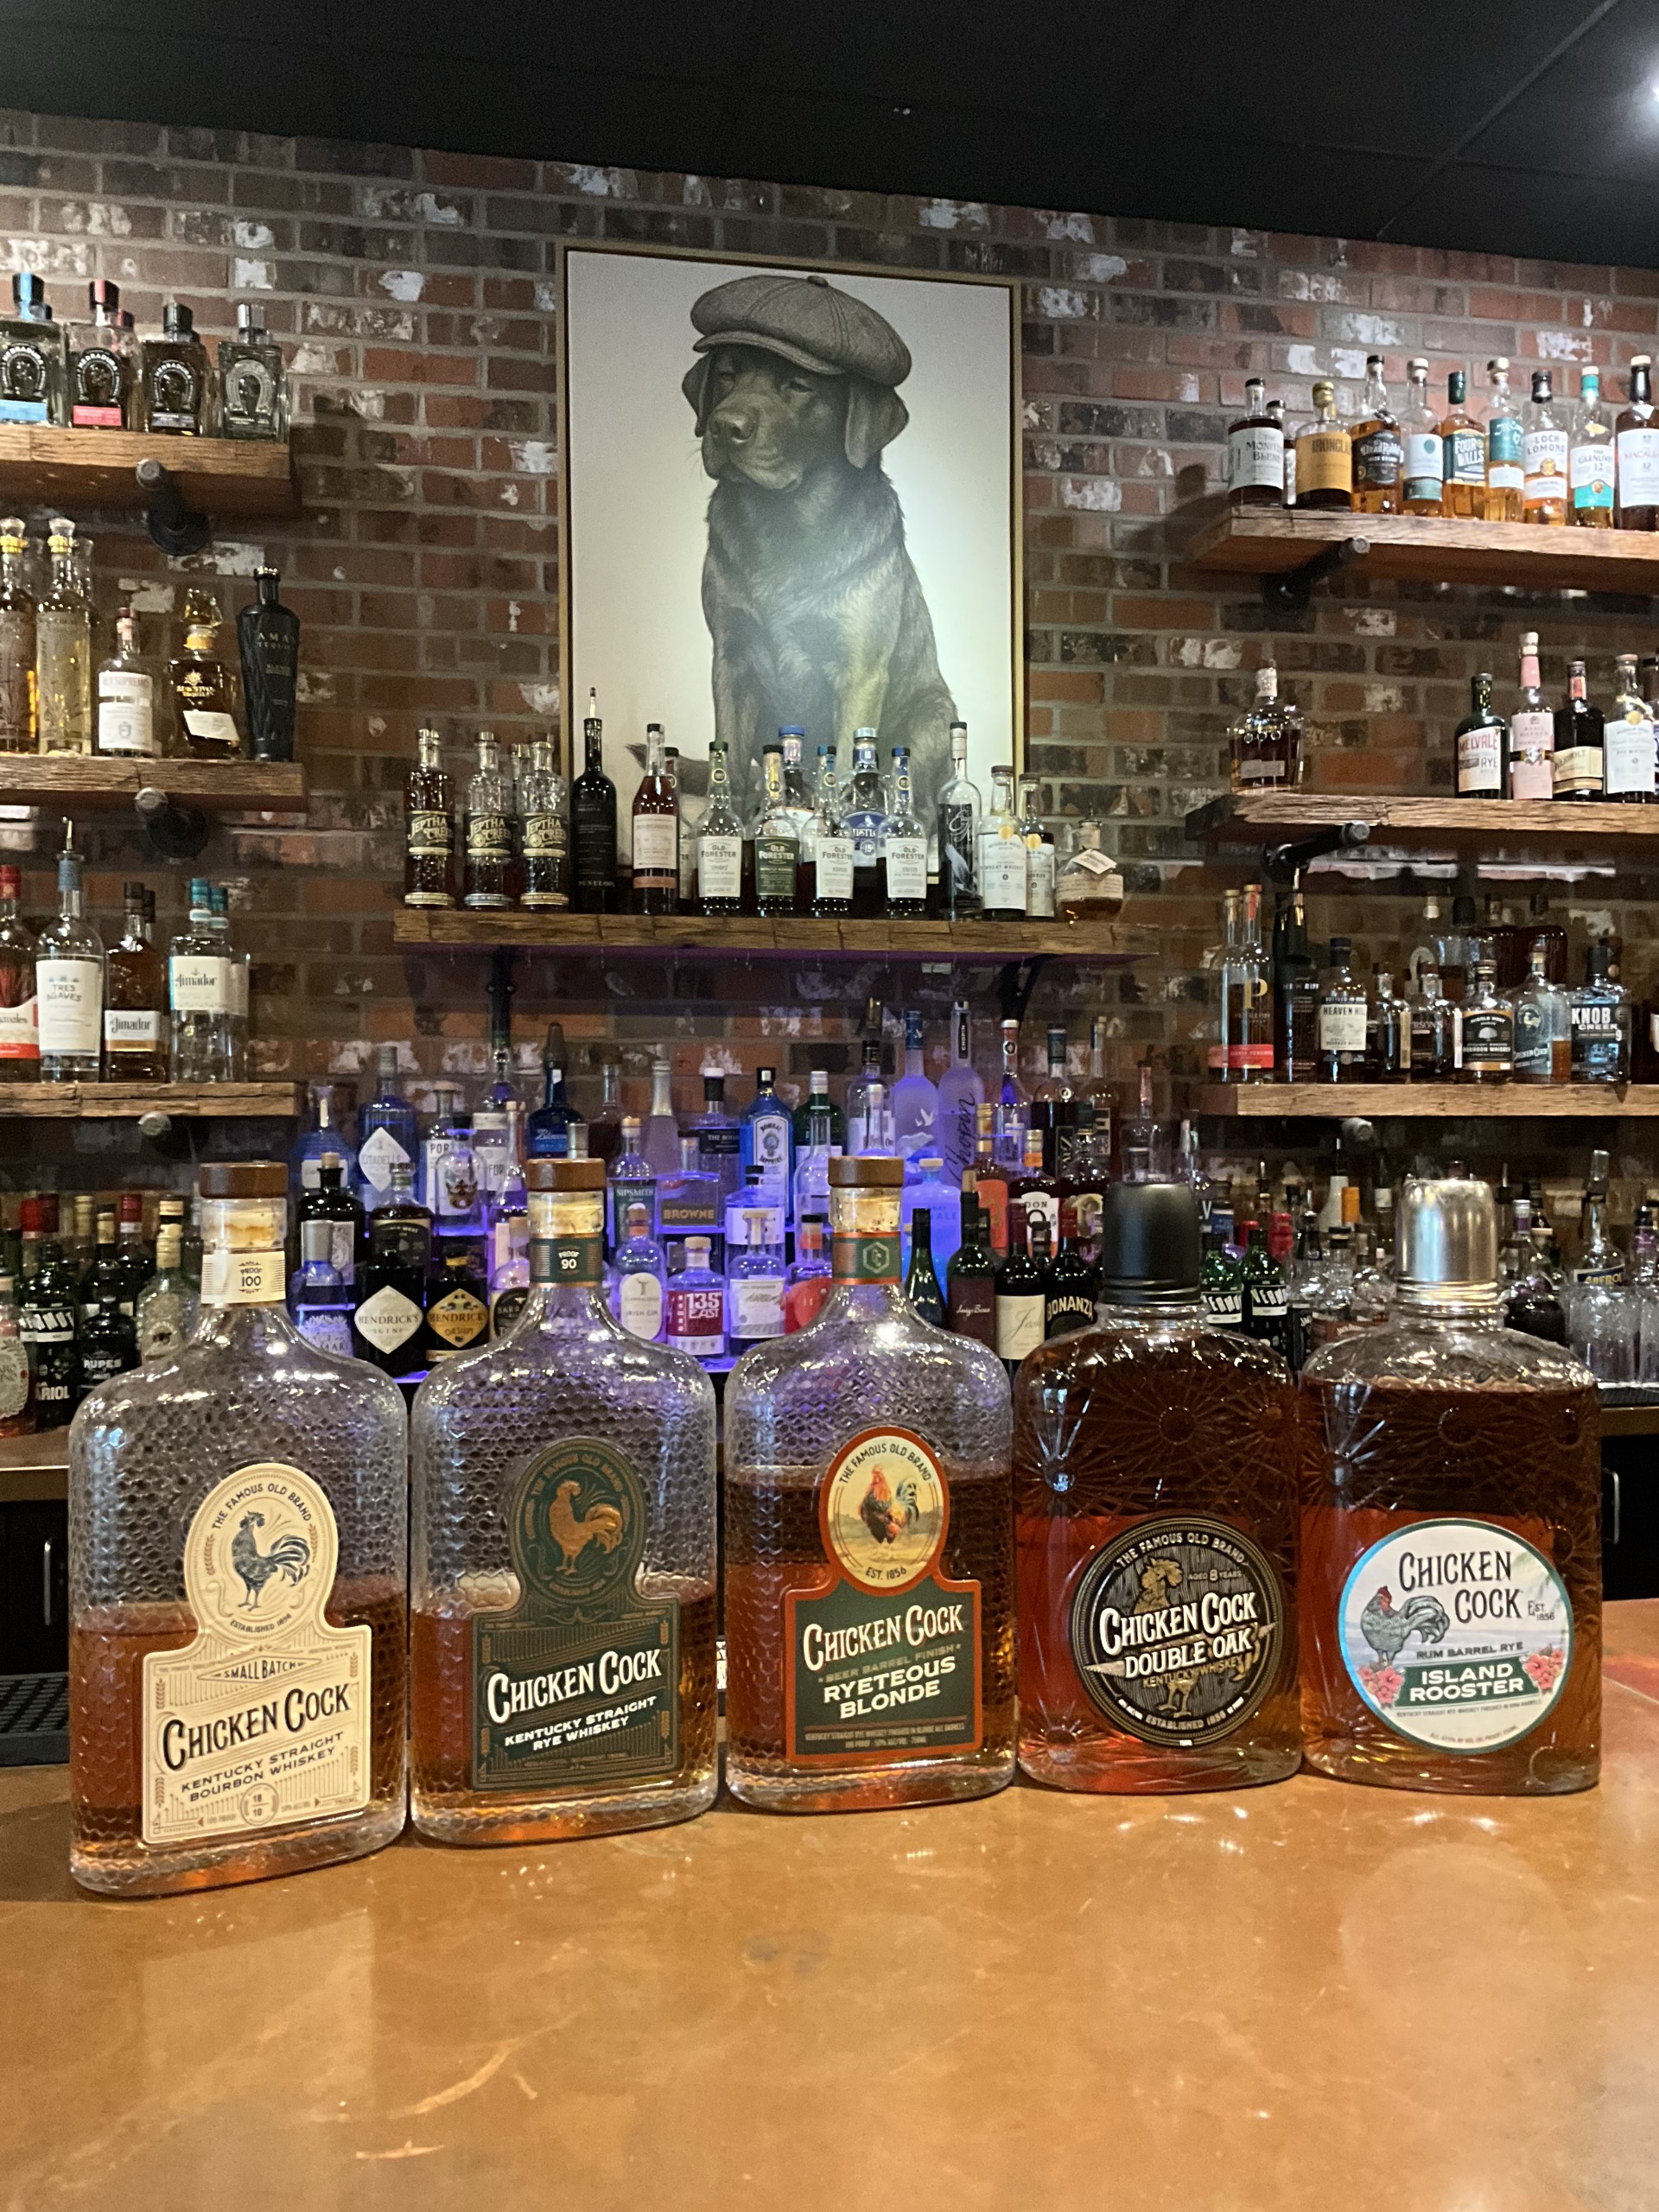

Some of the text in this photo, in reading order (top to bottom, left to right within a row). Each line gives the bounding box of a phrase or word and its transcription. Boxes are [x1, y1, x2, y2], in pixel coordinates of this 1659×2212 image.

[1535, 435, 1560, 444] LOCH
[1480, 757, 1498, 767] RYE
[759, 851, 795, 860] FORESTER
[1323, 1007, 1352, 1015] HEAVEN
[1572, 1007, 1611, 1025] KNOB
[663, 1209, 715, 1219] BROWNE
[562, 1258, 576, 1269] 90
[241, 1276, 262, 1287] 100
[1047, 1297, 1093, 1321] BONANZA
[839, 1443, 932, 1484] THE FAMOUS OLD BRAND
[213, 1483, 312, 1529] THE FAMOUS OLD BRAND
[1116, 1533, 1245, 1567] THE FAMOUS OLD BRAND
[865, 1567, 907, 1580] EST. 1856
[1210, 1569, 1217, 1581] 8
[1399, 1551, 1511, 1592] CHICKEN
[1455, 1589, 1522, 1624] COCK
[230, 1619, 275, 1633] ESTABLISHED
[803, 1605, 963, 1671] CHICKEN COCK
[1100, 1592, 1257, 1656] CHICKEN COCK
[862, 1656, 911, 1675] BARREL
[914, 1644, 955, 1662] FINISH
[1125, 1628, 1253, 1678] DOUBLE OAK
[1416, 1642, 1523, 1660] RUM BARREL RYE
[224, 1661, 259, 1679] SMALL
[262, 1659, 296, 1679] BATCH
[823, 1656, 956, 1704] RYETEOUS
[1143, 1656, 1244, 1688] KENTUCKY WHISKEY
[1422, 1663, 1513, 1686] ISLAND
[487, 1649, 662, 1724] CHICKEN COCK
[840, 1680, 941, 1719] BLONDE
[1409, 1679, 1523, 1701] ROOSTER
[162, 1683, 352, 1771] CHICKEN COCK
[505, 1695, 657, 1746] KENTUCKY STRAIGHT
[533, 1716, 629, 1751] RYE WHISKEY
[181, 1731, 344, 1792] KENTUCKY STRAIGHT
[189, 1746, 336, 1802] BOURBON WHISKEY
